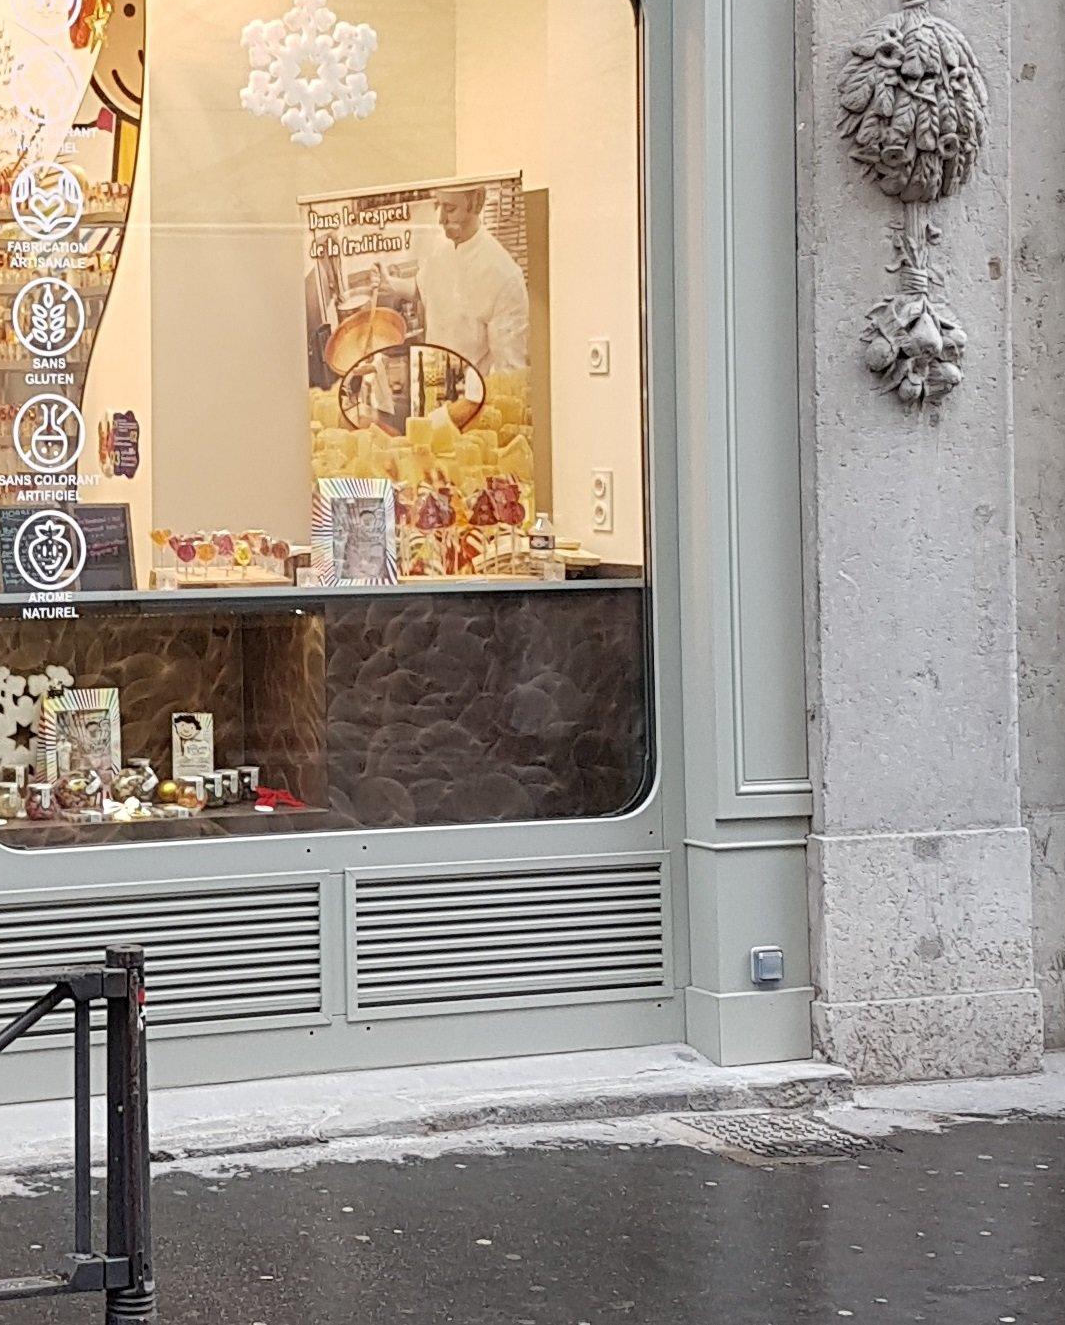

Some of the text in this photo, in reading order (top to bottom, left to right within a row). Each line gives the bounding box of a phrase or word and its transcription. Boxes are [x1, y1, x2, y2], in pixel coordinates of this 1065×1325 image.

[309, 202, 411, 231] Dans le respect
[7, 241, 88, 254] FABRICATION
[310, 240, 324, 258] de
[327, 237, 340, 256] la
[342, 233, 402, 256] tradition
[9, 257, 87, 270] ARTISANALE
[32, 357, 67, 370] SANS
[24, 373, 74, 385] GLUTEN
[33, 475, 102, 486] COLORANT
[16, 490, 83, 502] ARTIFICIEL
[27, 591, 73, 603] AROME
[22, 607, 80, 619] NATUREL
